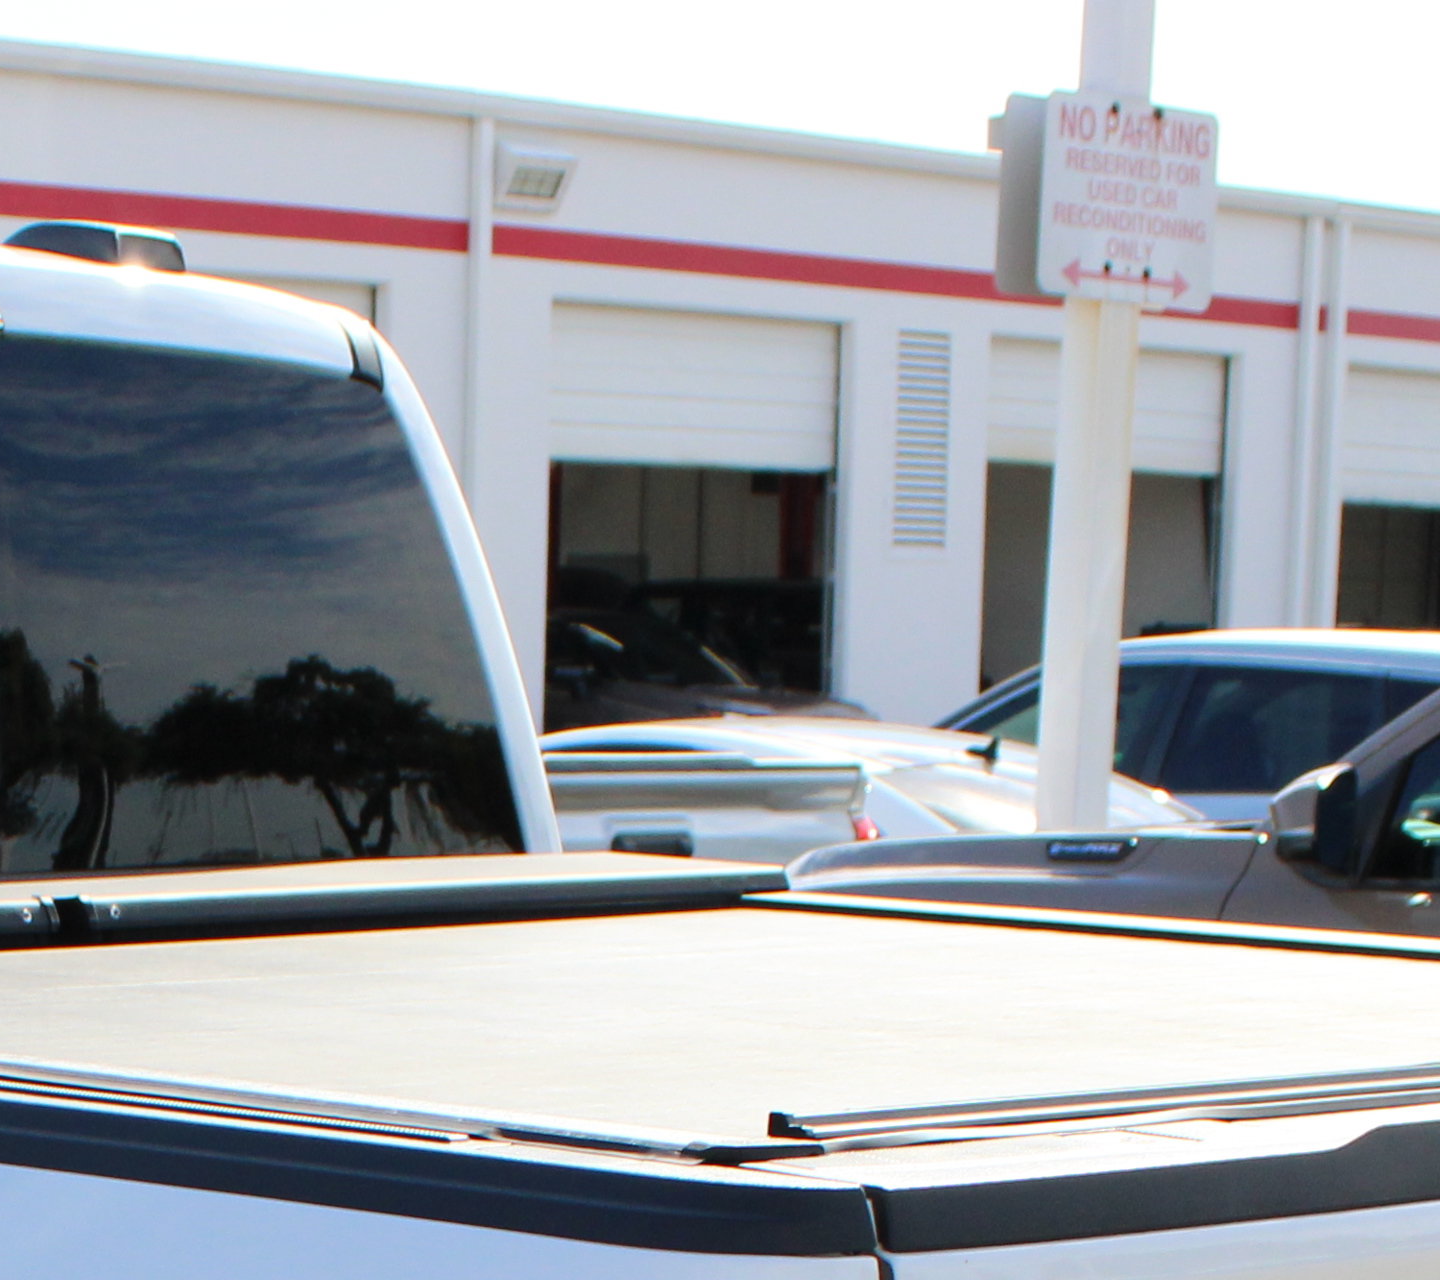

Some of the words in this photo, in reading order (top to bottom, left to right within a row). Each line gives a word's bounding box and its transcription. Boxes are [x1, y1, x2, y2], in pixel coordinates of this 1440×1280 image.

[1060, 104, 1096, 142] NO
[1104, 108, 1211, 160] PARKING
[1065, 147, 1161, 183] RESERVED
[1166, 161, 1201, 187] FOR
[1087, 177, 1137, 205] USED
[1141, 186, 1178, 210] CAR
[1052, 201, 1207, 244] RECONDITIONING
[1105, 236, 1156, 262] ONLY
